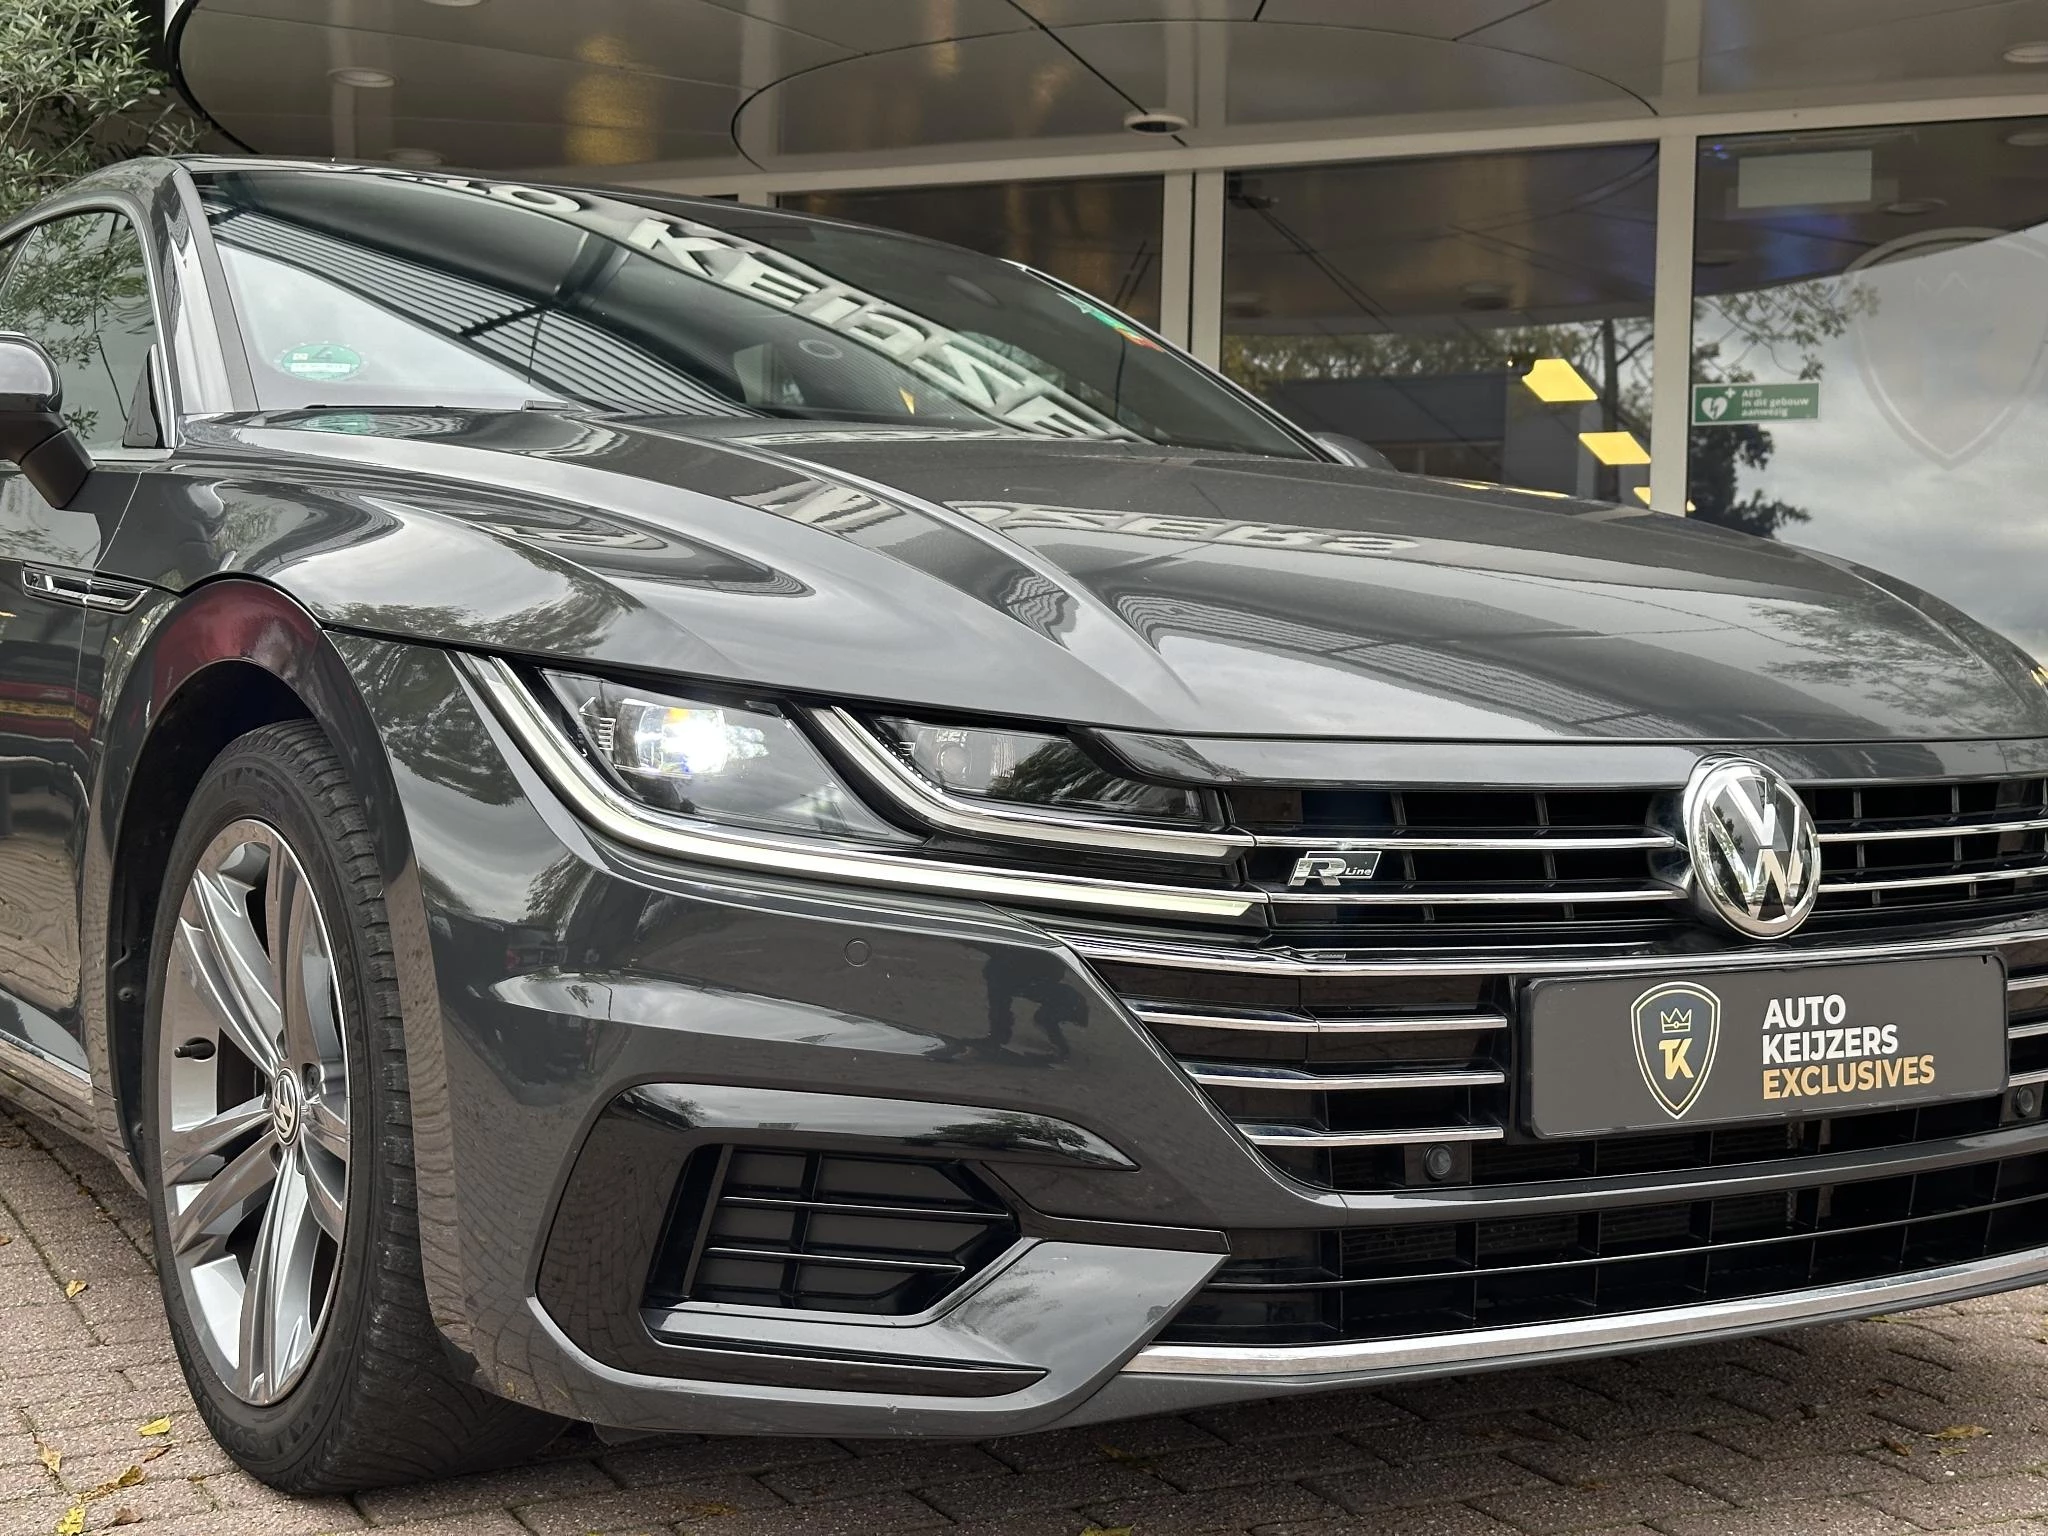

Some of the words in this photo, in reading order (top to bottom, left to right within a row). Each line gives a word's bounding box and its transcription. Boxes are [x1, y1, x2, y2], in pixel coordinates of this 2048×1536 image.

[1741, 388, 1763, 398] AED
[1753, 398, 1768, 407] dit
[1769, 397, 1810, 408] gebouw
[1741, 407, 1789, 418] aanwezig
[1287, 857, 1347, 886] R
[1344, 867, 1372, 876] Line
[1762, 994, 1846, 1030] AUTO
[1658, 1037, 1694, 1081] TK
[1762, 1023, 1899, 1065] KEIJZERS
[1763, 1054, 1935, 1100] EXCLUSIVES
